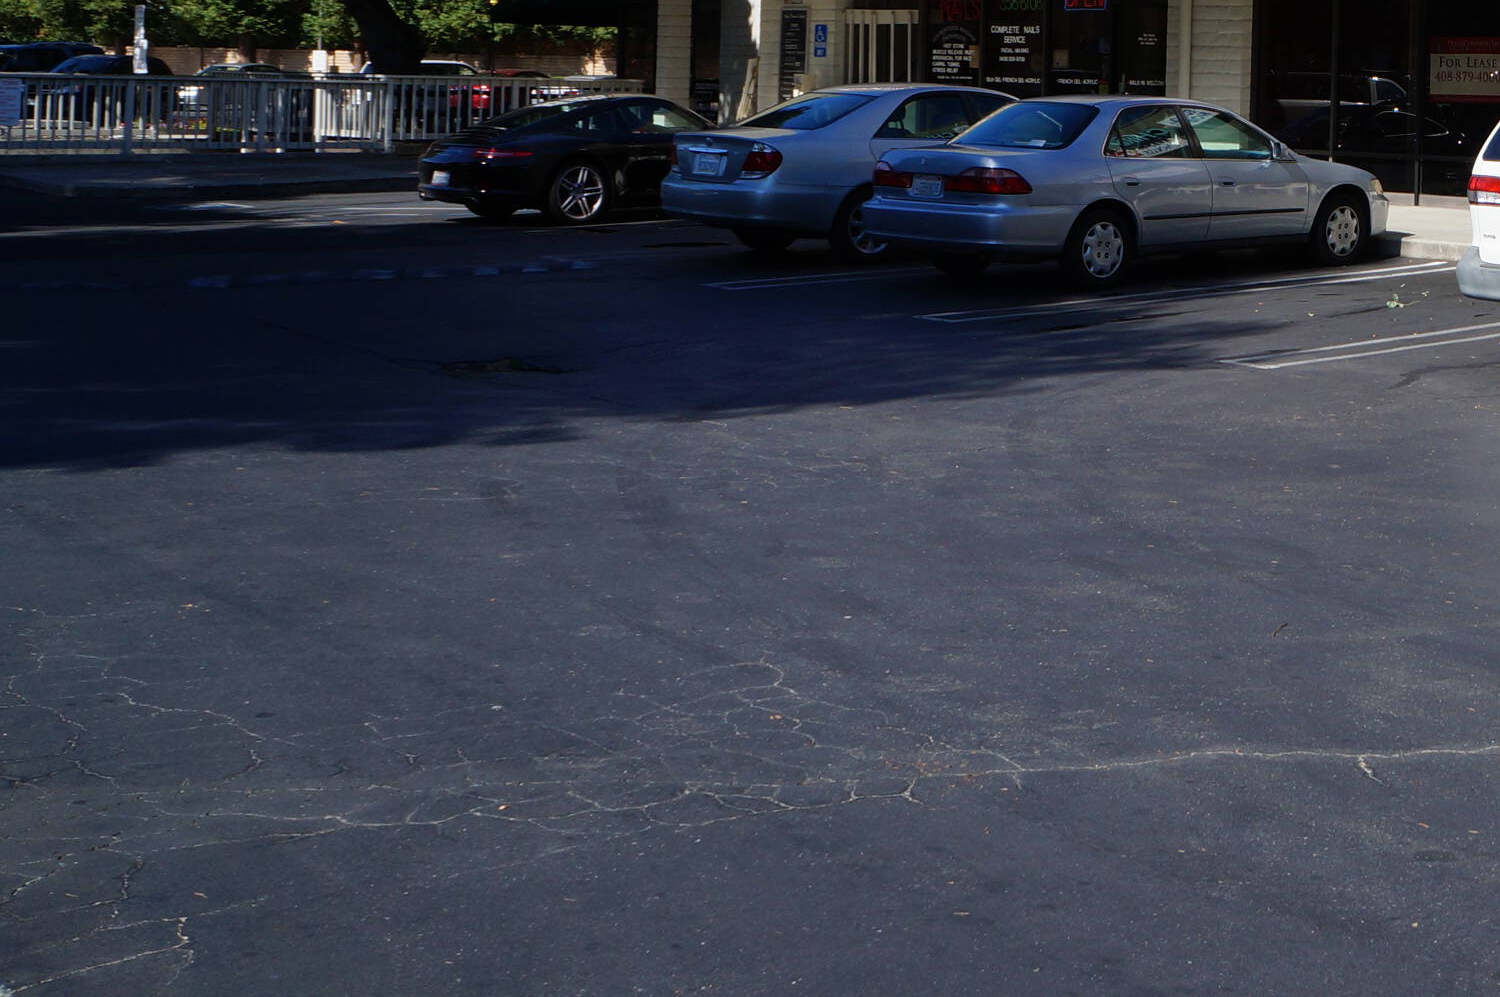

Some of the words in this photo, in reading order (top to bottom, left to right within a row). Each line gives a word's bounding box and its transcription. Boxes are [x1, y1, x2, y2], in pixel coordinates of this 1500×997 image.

[990, 25, 1020, 34] COMPLETE
[1023, 25, 1041, 34] NAILS
[1003, 35, 1026, 44] SERVICE
